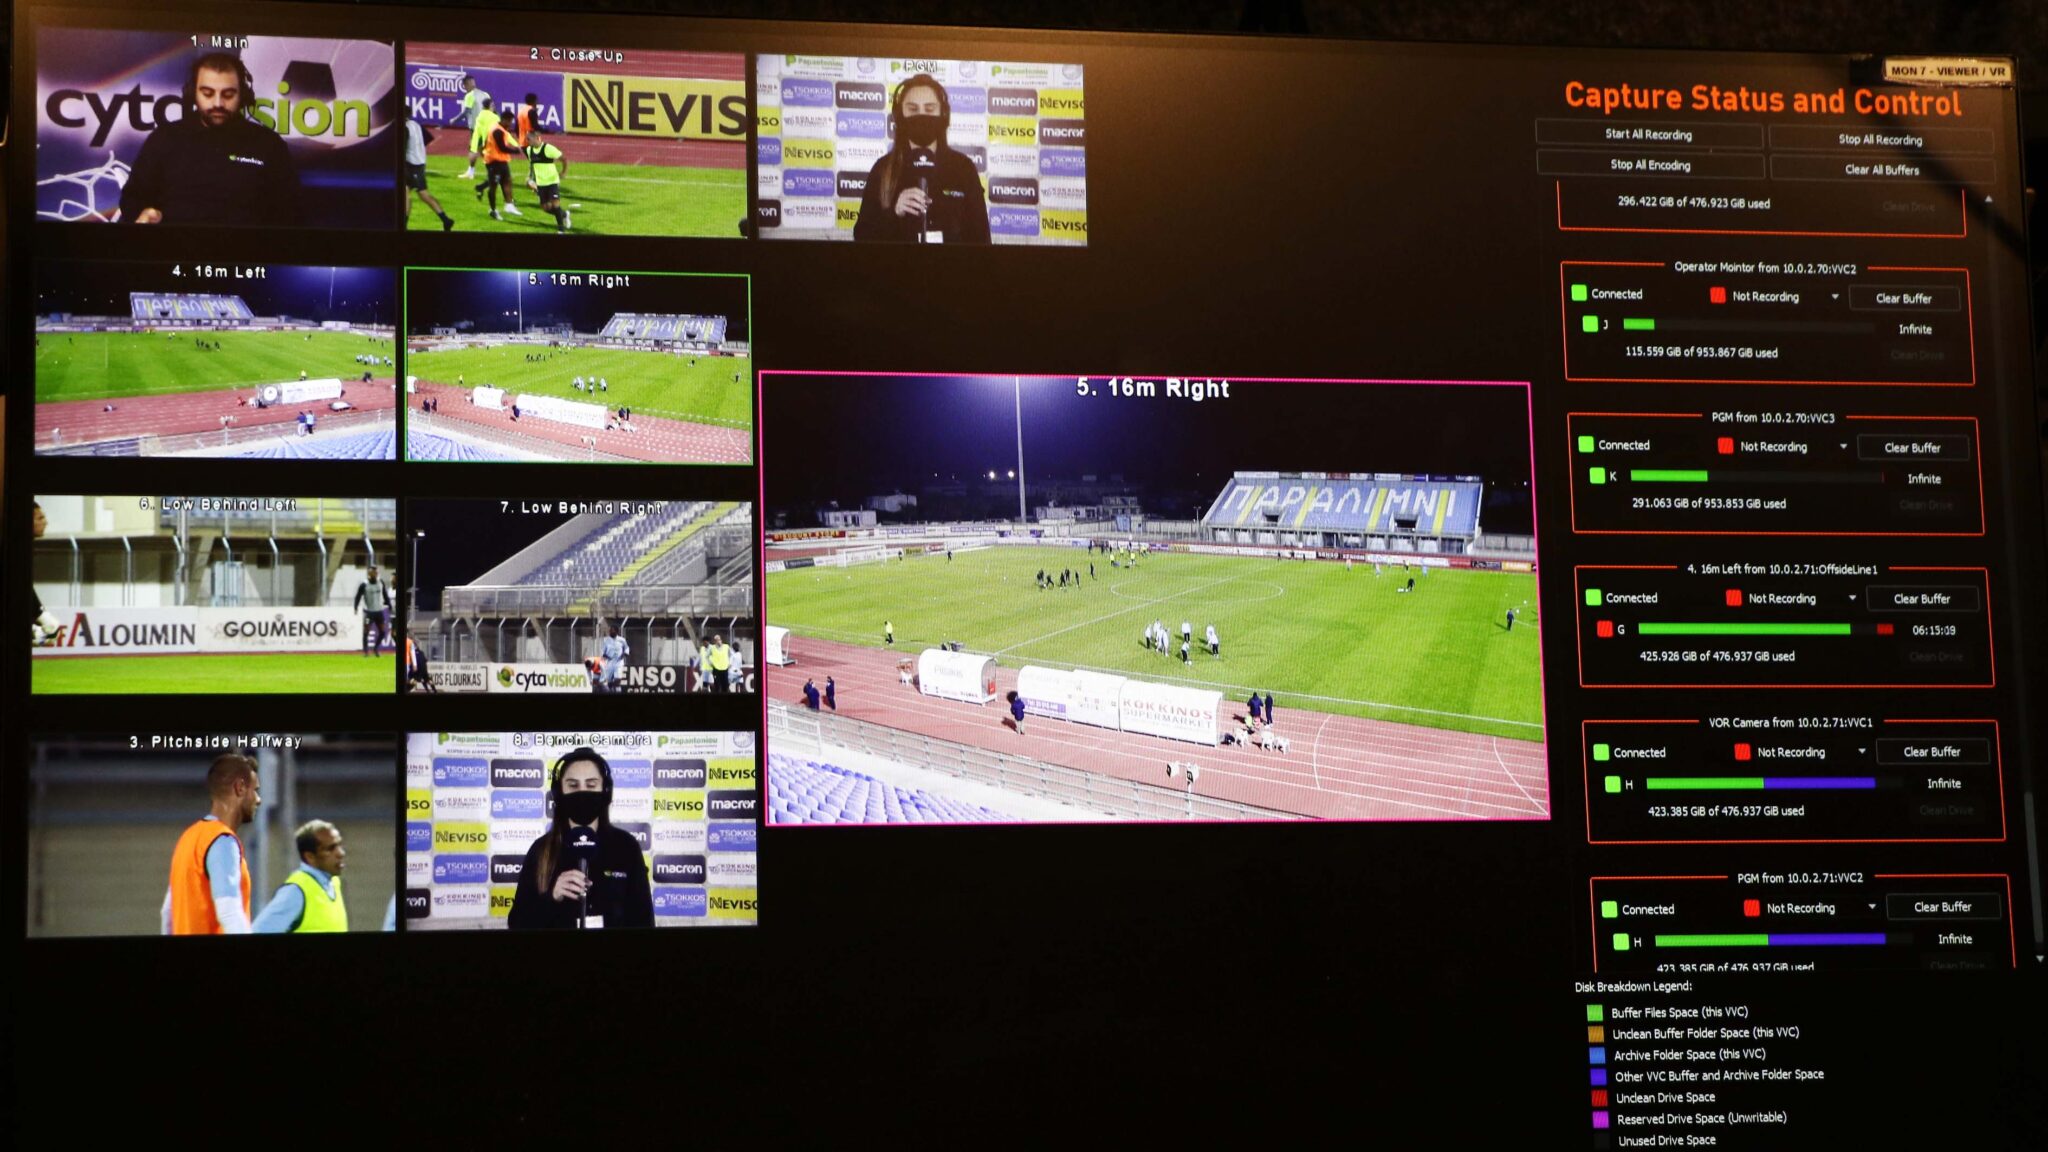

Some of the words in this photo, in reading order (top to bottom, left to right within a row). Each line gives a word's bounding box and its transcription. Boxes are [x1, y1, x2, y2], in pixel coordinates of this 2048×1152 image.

[191, 35, 204, 48] 1.
[212, 35, 248, 48] Main
[531, 48, 544, 60] 2.
[904, 60, 937, 72] PGM
[1891, 65, 1917, 76] MON
[1920, 65, 1926, 76] 7
[1936, 66, 1978, 76] VIEWER
[1989, 66, 2005, 77] VR
[840, 90, 882, 102] macron
[992, 96, 1035, 106] macron
[1565, 80, 1682, 114] Capture
[1691, 84, 1784, 112] Status
[1793, 87, 1845, 113] and
[1854, 88, 1962, 116] Control
[1605, 128, 1629, 138] Start
[1631, 128, 1642, 138] All
[1645, 129, 1692, 142] Recording
[1838, 133, 1860, 146] Stop
[1862, 133, 1874, 144] All
[1875, 134, 1922, 147] Recording
[784, 146, 833, 159] NEVISO
[1610, 158, 1632, 170] Stop
[1635, 159, 1646, 169] All
[1648, 159, 1690, 172] Encoding
[1845, 163, 1869, 174] Clear
[1872, 164, 1883, 174] All
[1885, 164, 1919, 175] Buffers
[992, 185, 1035, 196] macron
[172, 264, 186, 277] 4.
[195, 266, 228, 278] 16m
[236, 266, 266, 278] Left
[1674, 261, 1717, 272] Operator
[1719, 262, 1754, 272] Mointor
[1757, 261, 1779, 273] from
[1783, 263, 1856, 274] 10.0.2.70:VVC2
[529, 272, 542, 285] 5.
[550, 274, 581, 286] 16m
[588, 274, 630, 288] Right
[1591, 288, 1642, 299] Connected
[1733, 291, 1750, 301] Not
[1752, 291, 1799, 304] Recording
[1876, 293, 1900, 303] Clear
[1902, 292, 1931, 304] Buffer
[1603, 319, 1608, 329] J
[1899, 323, 1932, 334] Infinite
[1626, 346, 1664, 356] 115.559
[1666, 347, 1681, 356] GiB
[1684, 346, 1694, 357] of
[1696, 347, 1736, 358] 953.867
[1738, 348, 1753, 358] GiB
[1755, 348, 1778, 358] used
[1077, 376, 1096, 396] 5.
[1108, 377, 1156, 396] 16m
[1166, 378, 1230, 402] Right
[1711, 411, 1733, 422] PGM
[1735, 411, 1757, 422] from
[1761, 412, 1834, 423] 10.0.2.70:VVC3
[140, 498, 155, 510] 6.
[162, 498, 194, 510] Low
[201, 498, 258, 510] Behind
[265, 498, 296, 511] Left
[500, 501, 514, 513] 7.
[522, 502, 552, 514] Low
[558, 502, 613, 514] Behind
[620, 502, 662, 516] Right
[1687, 564, 1696, 573] 4.
[1701, 563, 1719, 574] 16m
[1721, 562, 1741, 574] Left
[1743, 562, 1765, 574] from
[1769, 563, 1877, 574] 10.0.2.71:OffsideLine1
[1605, 592, 1657, 603] Connected
[1749, 593, 1766, 603] Not
[1768, 593, 1816, 605] Recording
[1894, 593, 1918, 604] Clear
[1921, 593, 1950, 604] Buffer
[223, 620, 338, 638] GOUMENOS
[1617, 624, 1624, 634] G
[1639, 650, 1679, 661] 425.926
[1681, 650, 1697, 661] GiB
[1699, 649, 1710, 661] of
[1712, 650, 1752, 661] 476.937
[1754, 651, 1769, 661] GiB
[1771, 650, 1795, 661] used
[1123, 698, 1212, 720] KOKKINOS
[1123, 708, 1212, 728] SUPERMARKET
[1709, 717, 1730, 727] VOR
[1732, 717, 1769, 727] Camera
[1772, 716, 1794, 727] from
[1798, 717, 1872, 727] 10.0.2.71:VVC1
[130, 736, 144, 748] 3.
[152, 735, 230, 748] Pitchside
[238, 735, 302, 749] Halfway
[514, 733, 528, 746] 8.
[534, 733, 584, 746] Bench
[590, 733, 652, 746] Camera
[495, 768, 540, 778] macron
[657, 768, 704, 779] macron
[654, 800, 704, 811] NEVISO
[436, 830, 488, 843] NEVISO
[656, 864, 702, 874] macron
[1737, 873, 1759, 883] PGM
[1761, 872, 1783, 883] from
[1787, 872, 1863, 883] 10.0.2.71:VVC2
[1574, 981, 1595, 992] Disk
[1596, 980, 1650, 992] Breakdown
[1653, 979, 1692, 993] Legend:
[1611, 1006, 1642, 1018] Buffer
[1644, 1006, 1666, 1017] Files
[1668, 1007, 1698, 1019] Space
[1701, 1005, 1722, 1018] (this
[1724, 1005, 1748, 1018] VVC)
[1612, 1028, 1651, 1039] Unclean
[1654, 1027, 1684, 1039] Buffer
[1687, 1027, 1717, 1038] Folder
[1720, 1027, 1749, 1039] Space
[1752, 1026, 1773, 1039] (this
[1776, 1025, 1799, 1038] VVC)
[1614, 1049, 1650, 1060] Archive
[1653, 1048, 1683, 1060] Folder
[1686, 1049, 1715, 1061] Space
[1719, 1047, 1740, 1061] (this
[1742, 1047, 1765, 1060] VVC)
[1615, 1070, 1643, 1082] Other
[1646, 1070, 1666, 1081] VVC
[1668, 1069, 1698, 1081] Buffer
[1701, 1069, 1720, 1080] and
[1722, 1069, 1759, 1080] Archive
[1761, 1068, 1792, 1079] Folder
[1794, 1068, 1824, 1081] Space
[1616, 1091, 1655, 1103] Unclean
[1657, 1092, 1683, 1102] Drive
[1686, 1091, 1715, 1104] Space
[1617, 1112, 1664, 1124] Reserved
[1666, 1113, 1692, 1123] Drive
[1695, 1113, 1724, 1125] Space
[1728, 1110, 1786, 1124] (Unwritable)
